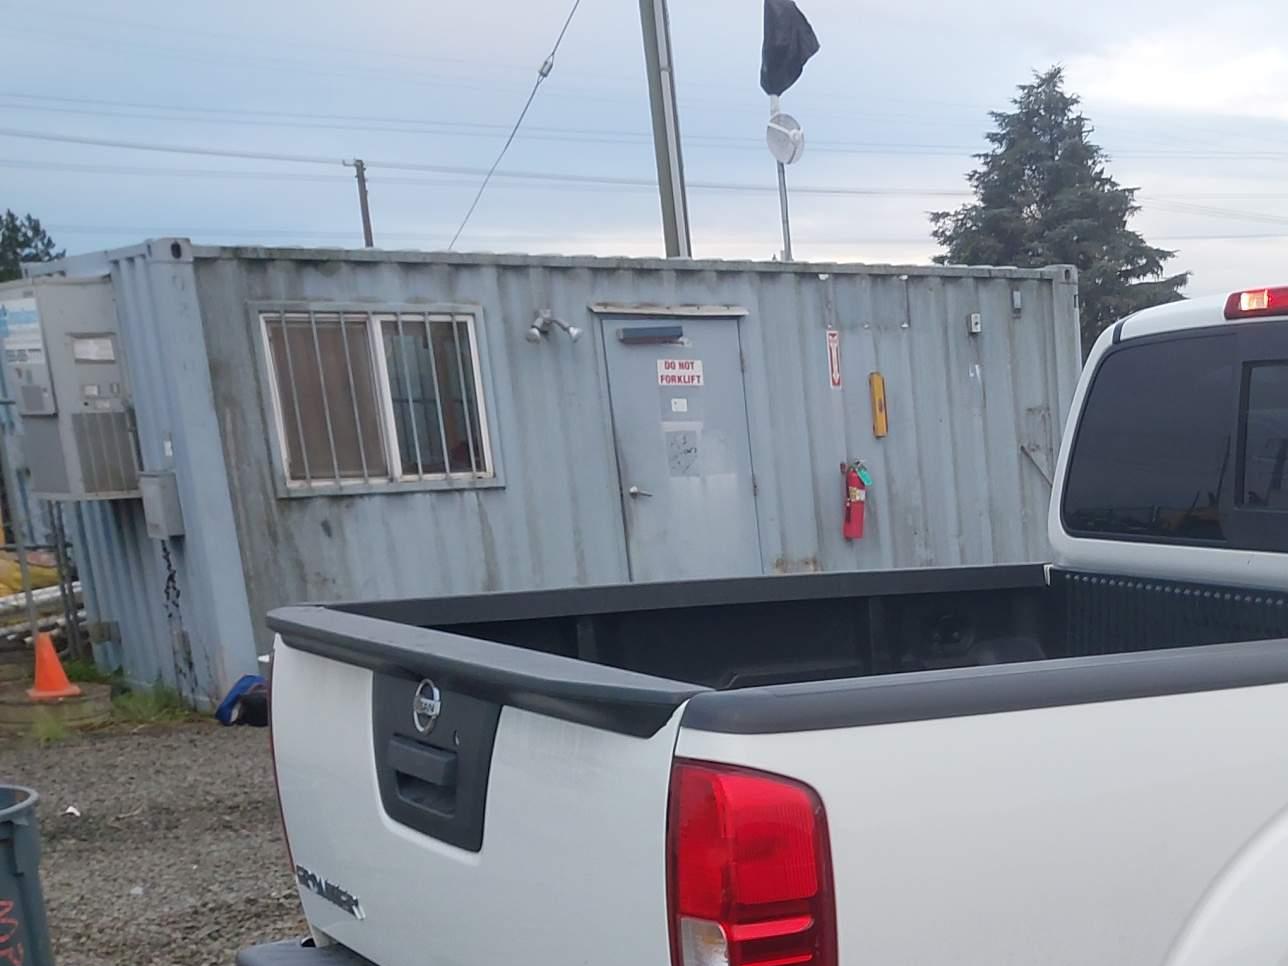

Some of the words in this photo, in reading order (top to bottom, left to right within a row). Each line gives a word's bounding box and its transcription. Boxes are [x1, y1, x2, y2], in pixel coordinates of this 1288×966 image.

[664, 361, 676, 370] DO
[678, 361, 695, 370] NOT
[660, 374, 701, 384] FORKLIFT
